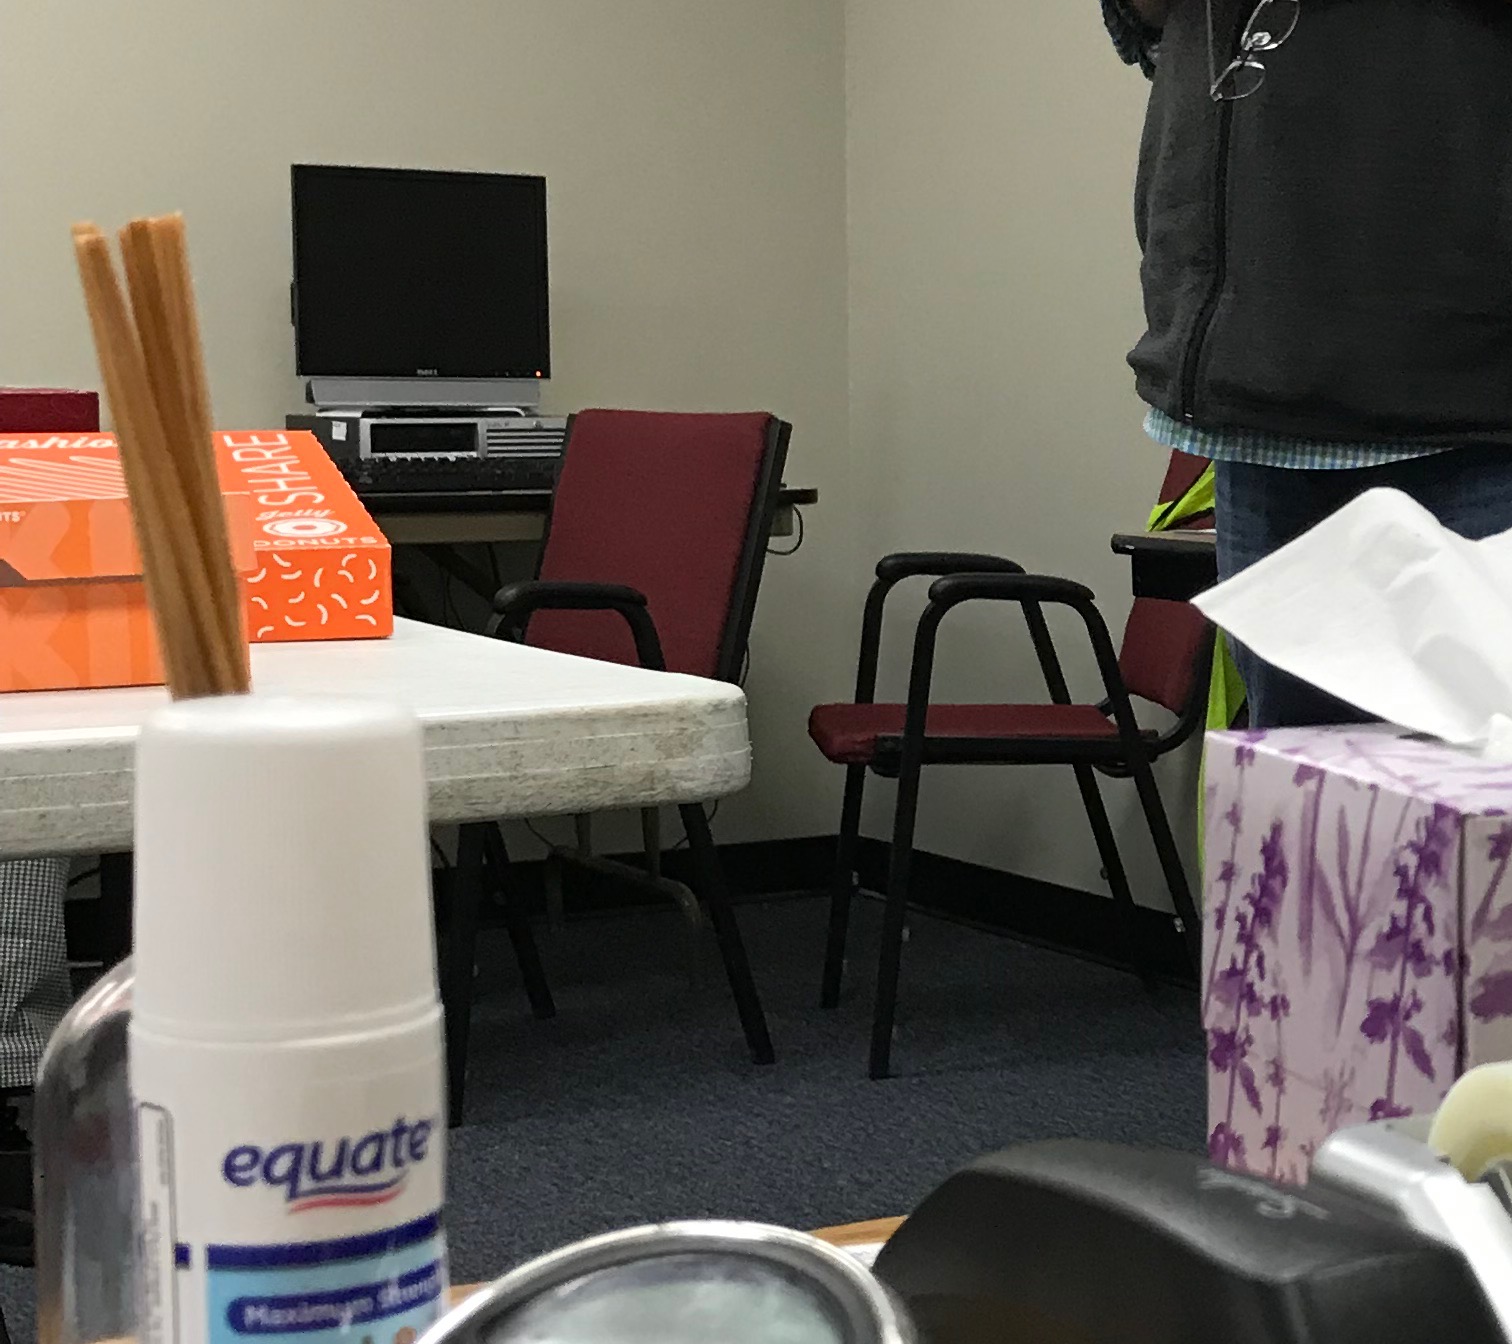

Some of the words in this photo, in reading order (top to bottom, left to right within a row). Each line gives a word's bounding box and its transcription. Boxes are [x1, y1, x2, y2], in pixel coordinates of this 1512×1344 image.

[0, 435, 118, 449] ashio
[223, 433, 326, 506] SHARE
[255, 508, 335, 521] Jelly
[253, 535, 378, 548] DONUTS
[221, 1115, 433, 1202] equate
